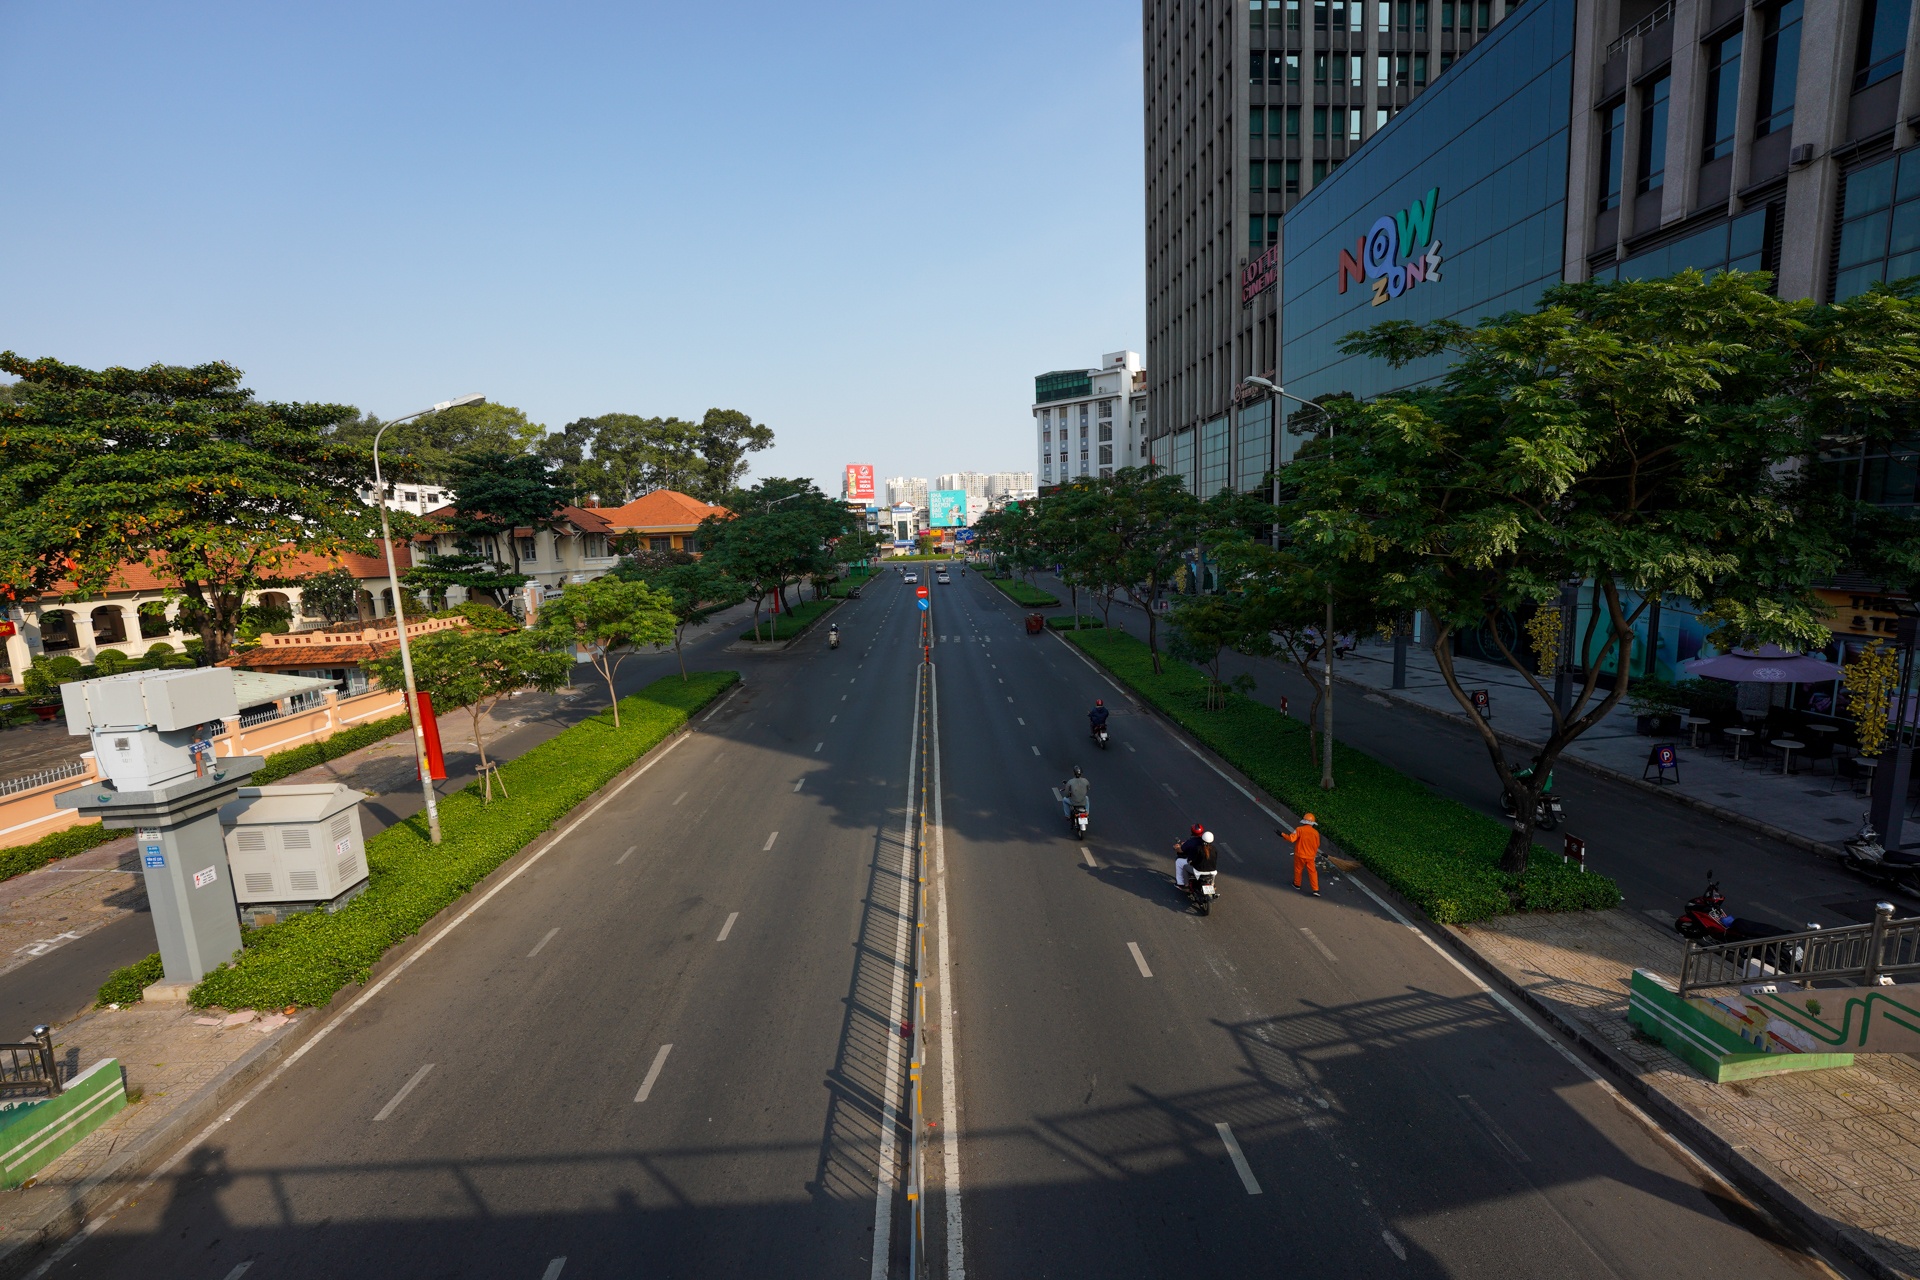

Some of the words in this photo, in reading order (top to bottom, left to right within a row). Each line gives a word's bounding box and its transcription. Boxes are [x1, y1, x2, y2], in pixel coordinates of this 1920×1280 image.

[1338, 187, 1440, 295] NOW
[1242, 268, 1278, 303] CINEMA
[1371, 240, 1443, 307] ZONE
[1870, 616, 1898, 632] TE
